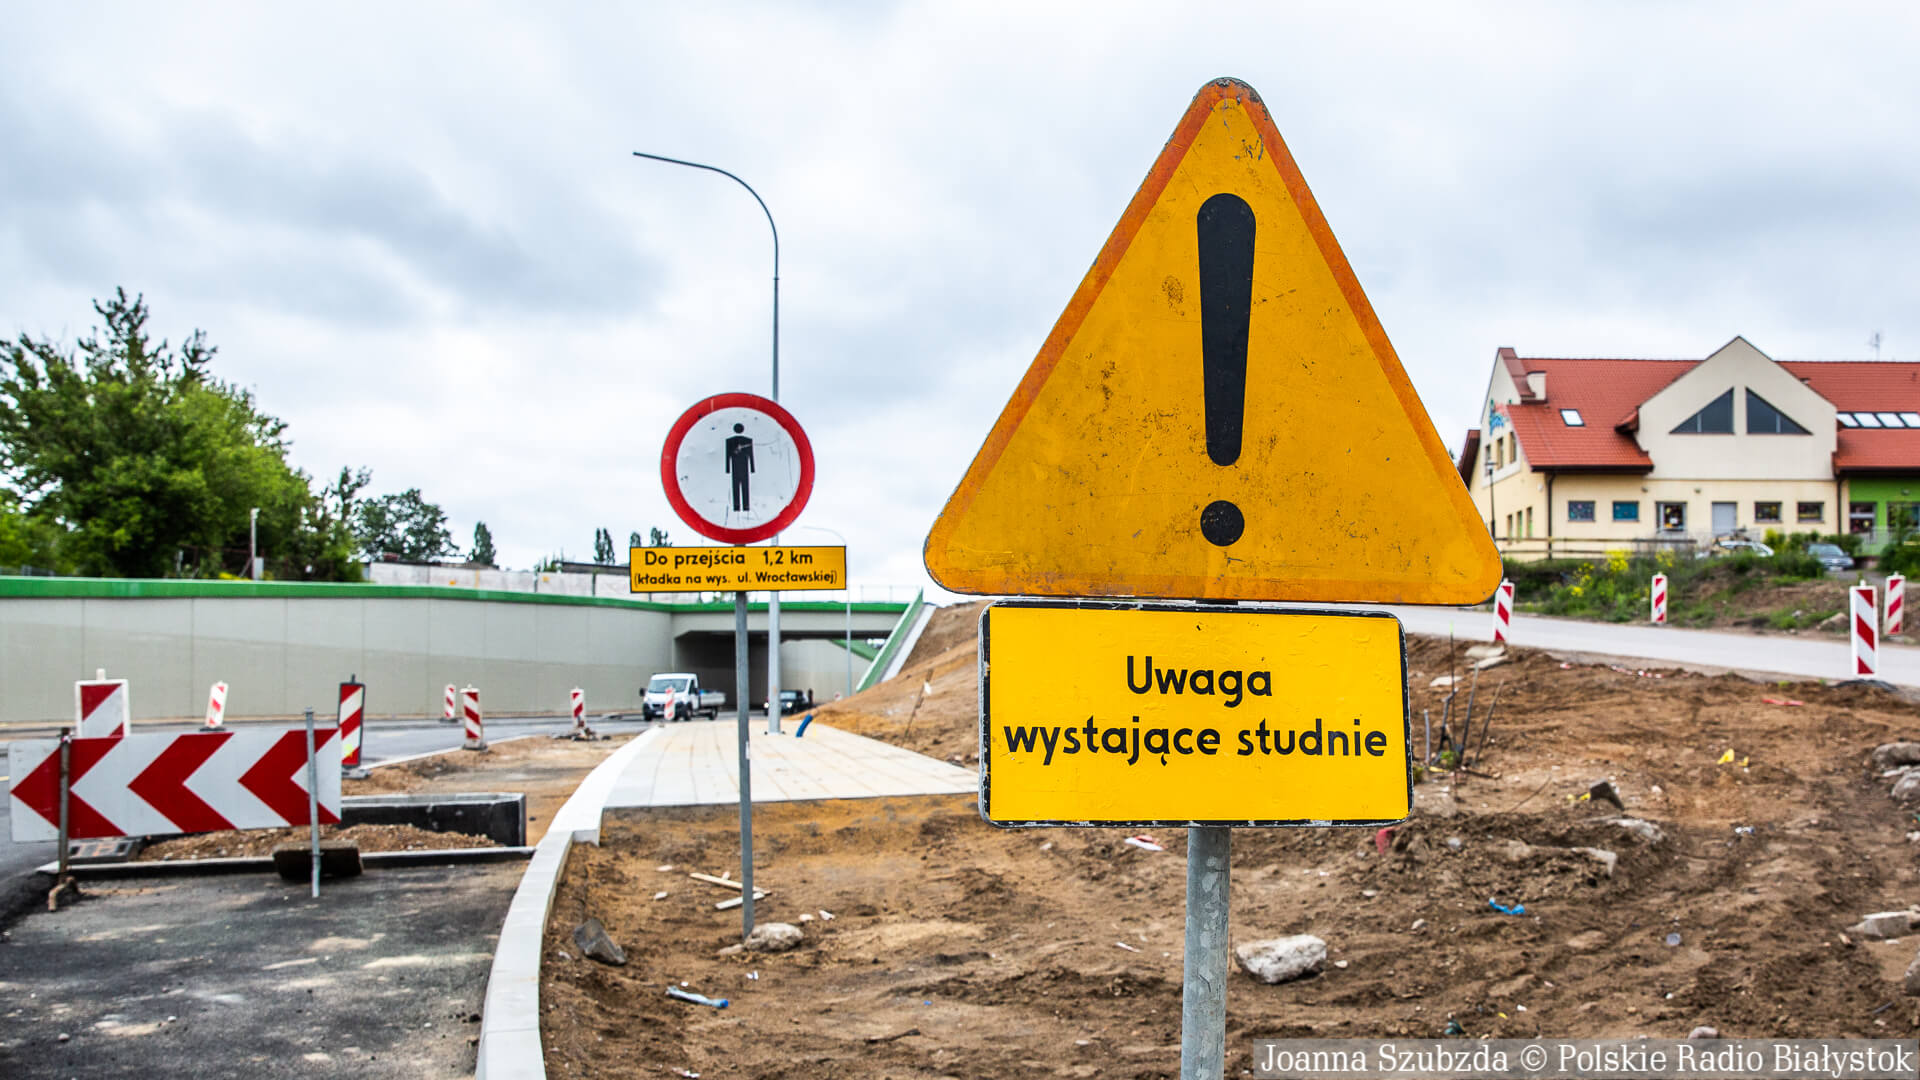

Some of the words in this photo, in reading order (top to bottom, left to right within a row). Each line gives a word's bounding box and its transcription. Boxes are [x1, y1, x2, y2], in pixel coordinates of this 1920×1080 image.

[645, 551, 668, 565] Do
[675, 550, 745, 569] przejścia
[763, 551, 783, 567] 1,2
[790, 550, 813, 565] km
[634, 572, 681, 588] (kładka
[686, 576, 701, 585] na
[706, 575, 731, 587] wys.
[737, 572, 751, 584] ul.
[755, 571, 838, 585] Wrocławskiej)
[1127, 655, 1272, 708] Uwaga
[1003, 715, 1221, 766] wystające
[1237, 718, 1388, 757] studnie
